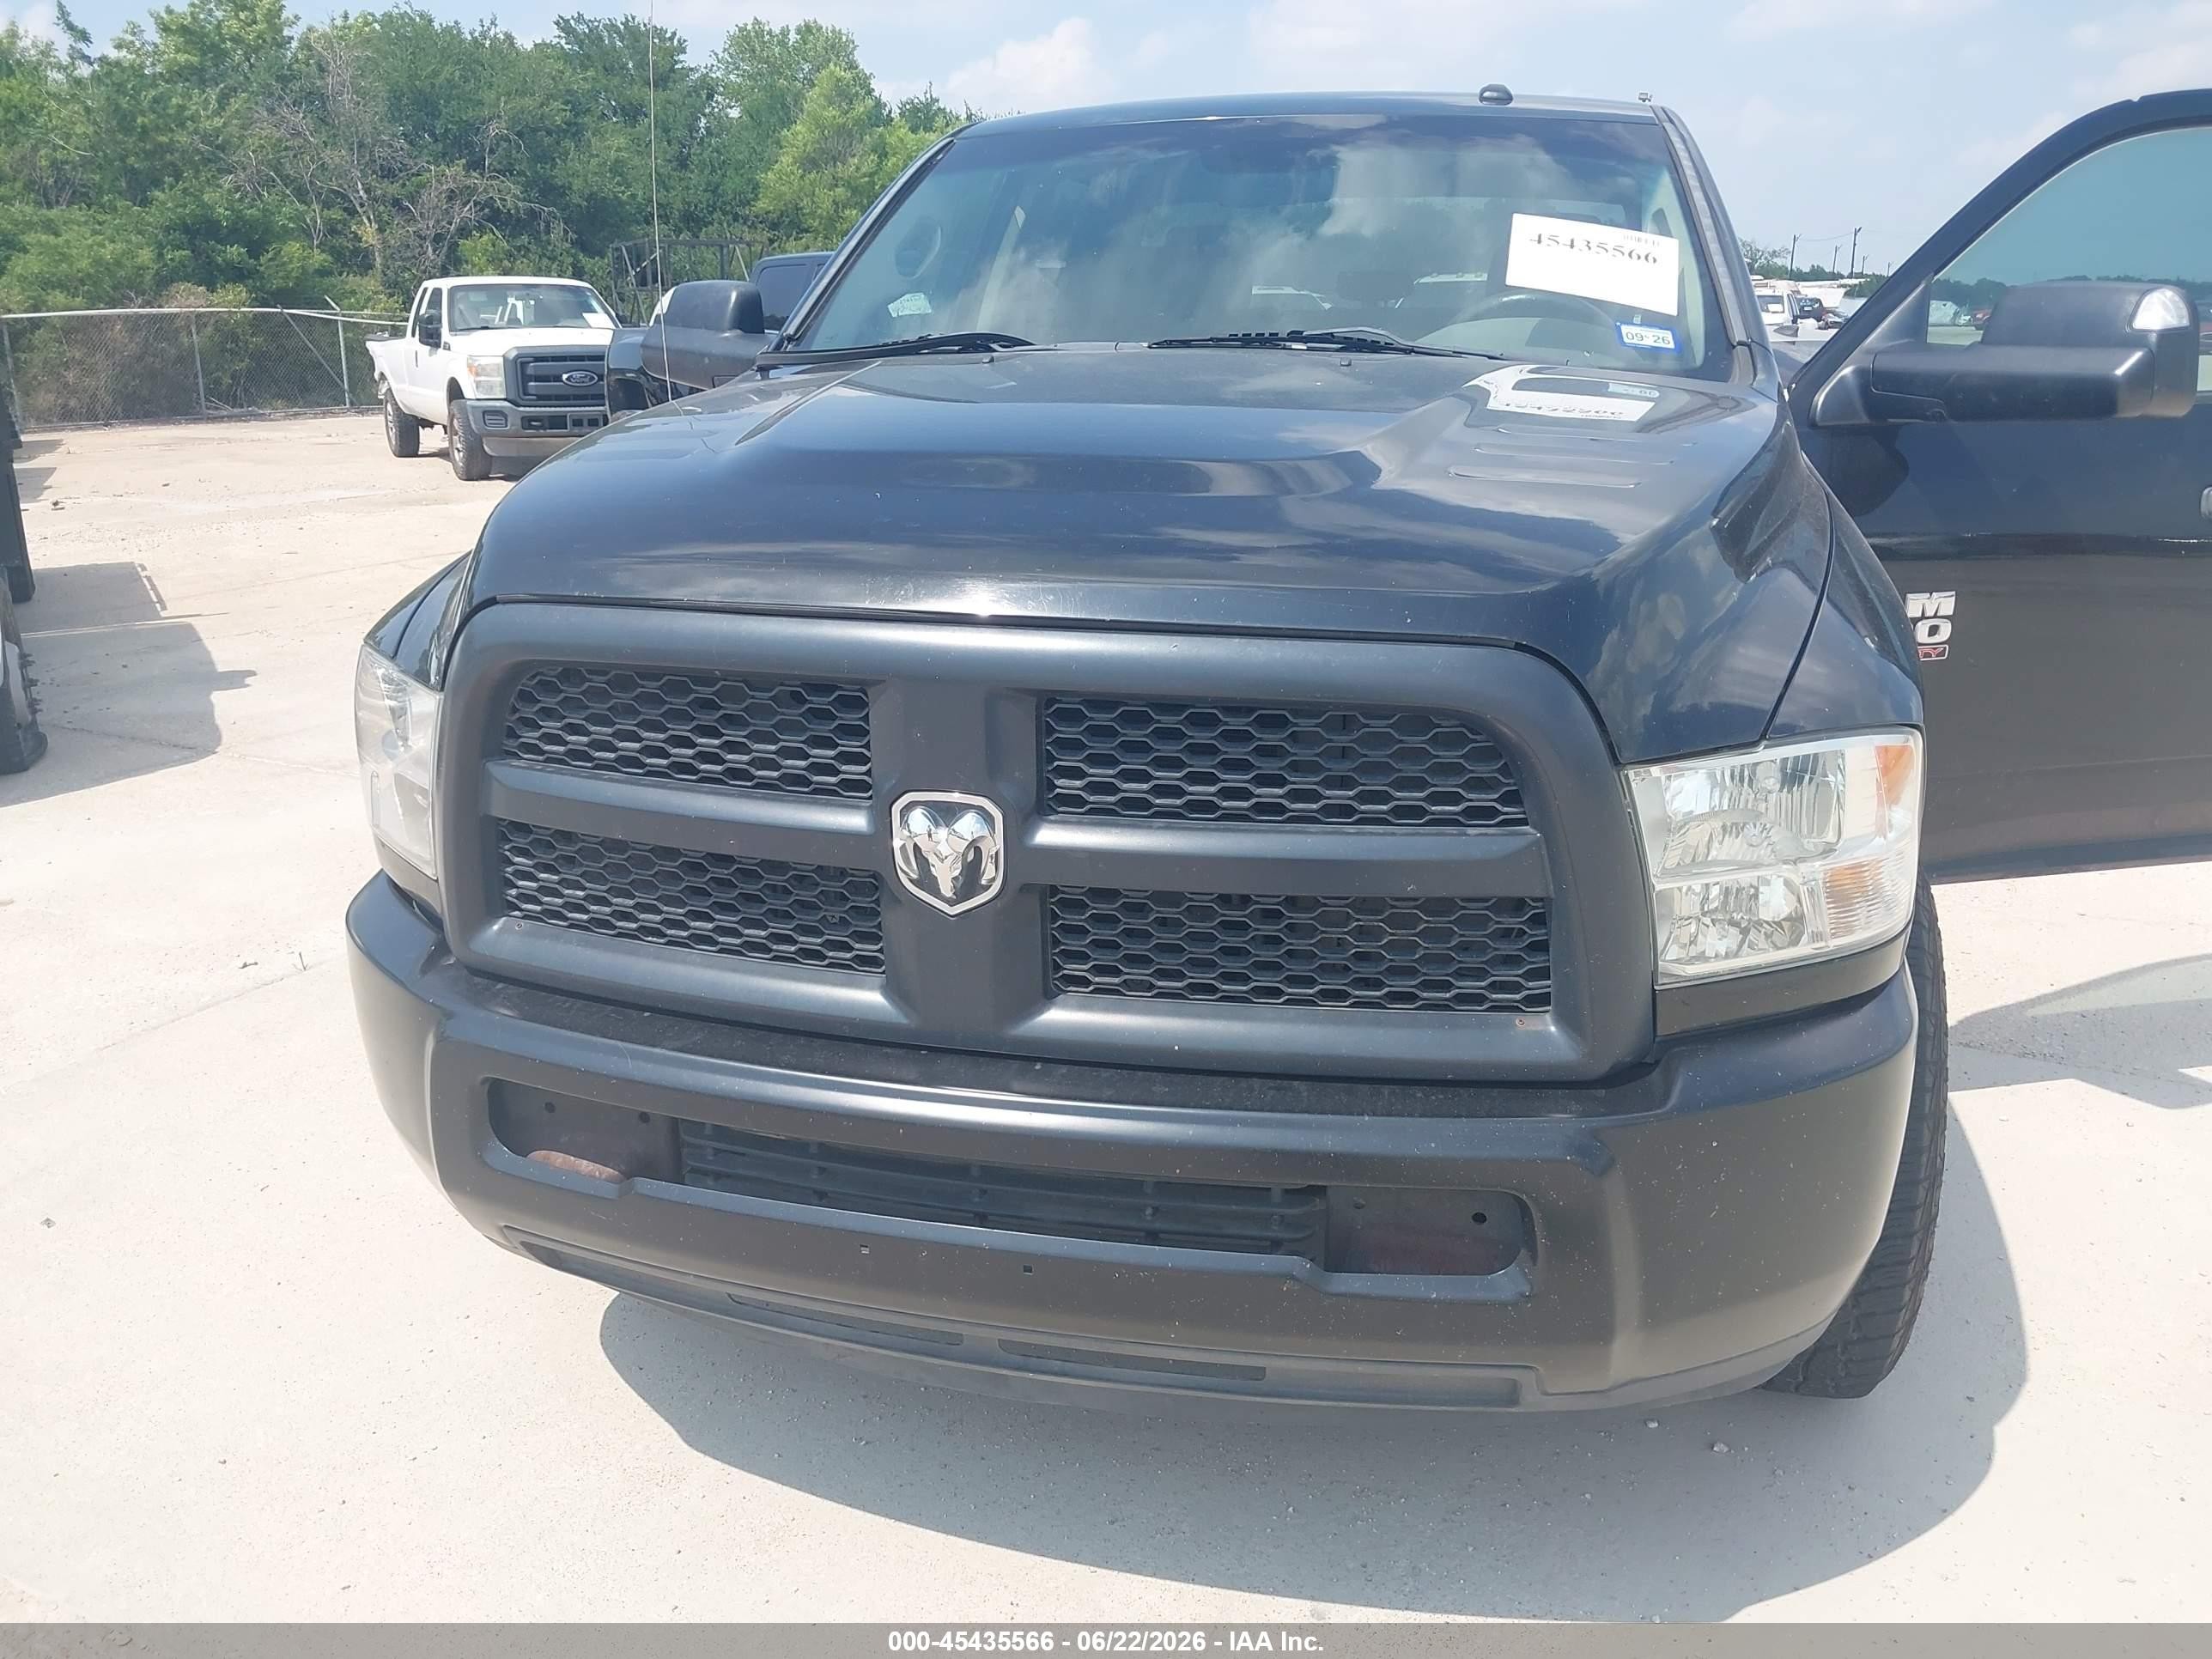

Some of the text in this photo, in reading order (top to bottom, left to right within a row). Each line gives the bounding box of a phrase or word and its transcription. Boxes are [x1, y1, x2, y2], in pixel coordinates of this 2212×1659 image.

[1528, 233, 1658, 264] 45435566
[1625, 331, 1671, 345] 09 26
